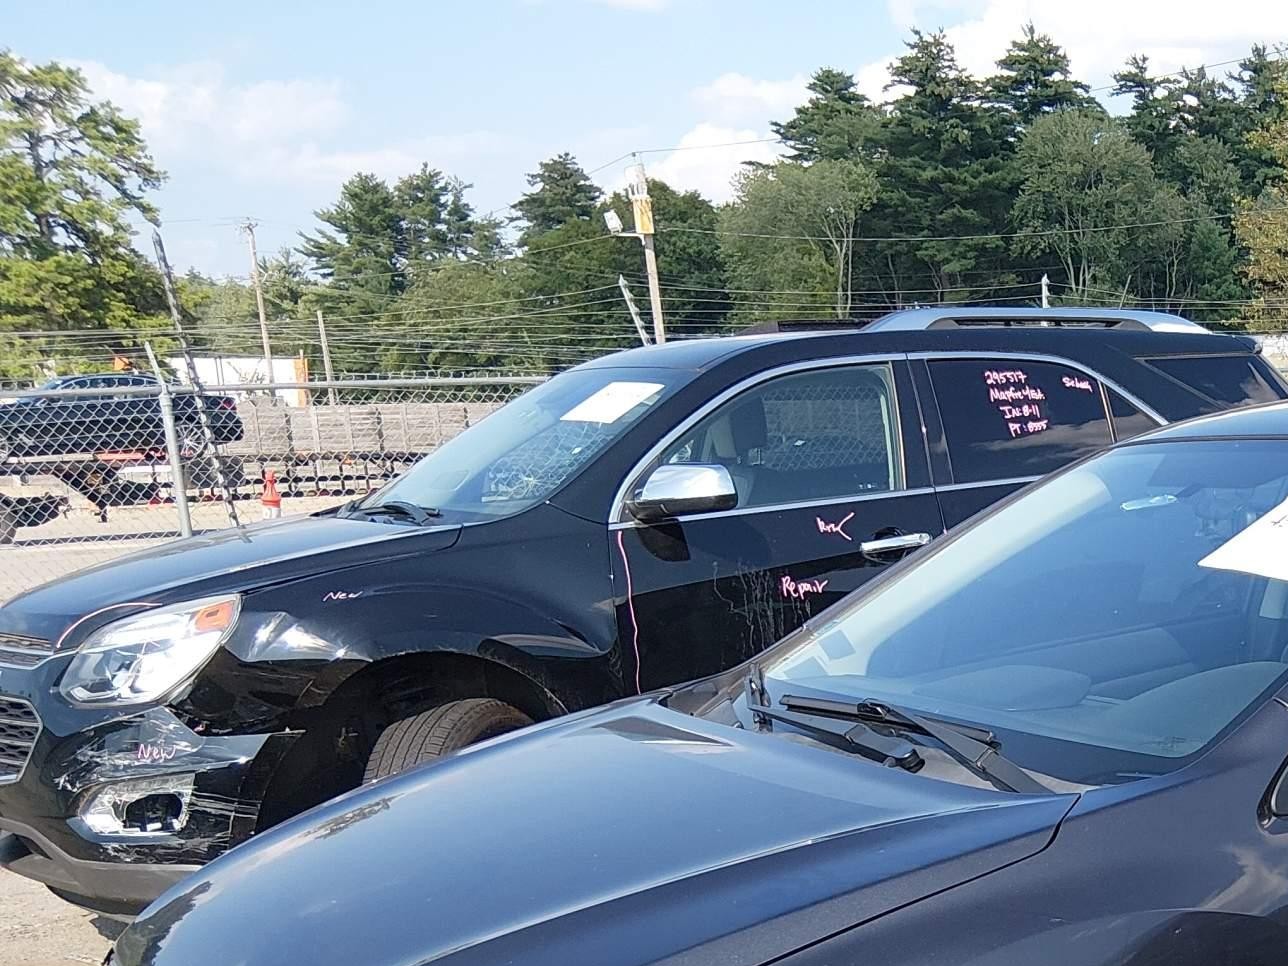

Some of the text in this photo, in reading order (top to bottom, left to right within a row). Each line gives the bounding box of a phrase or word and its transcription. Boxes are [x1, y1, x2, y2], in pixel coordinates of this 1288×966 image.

[322, 591, 364, 602] New
[781, 576, 829, 600] Repair
[137, 743, 177, 761] New
